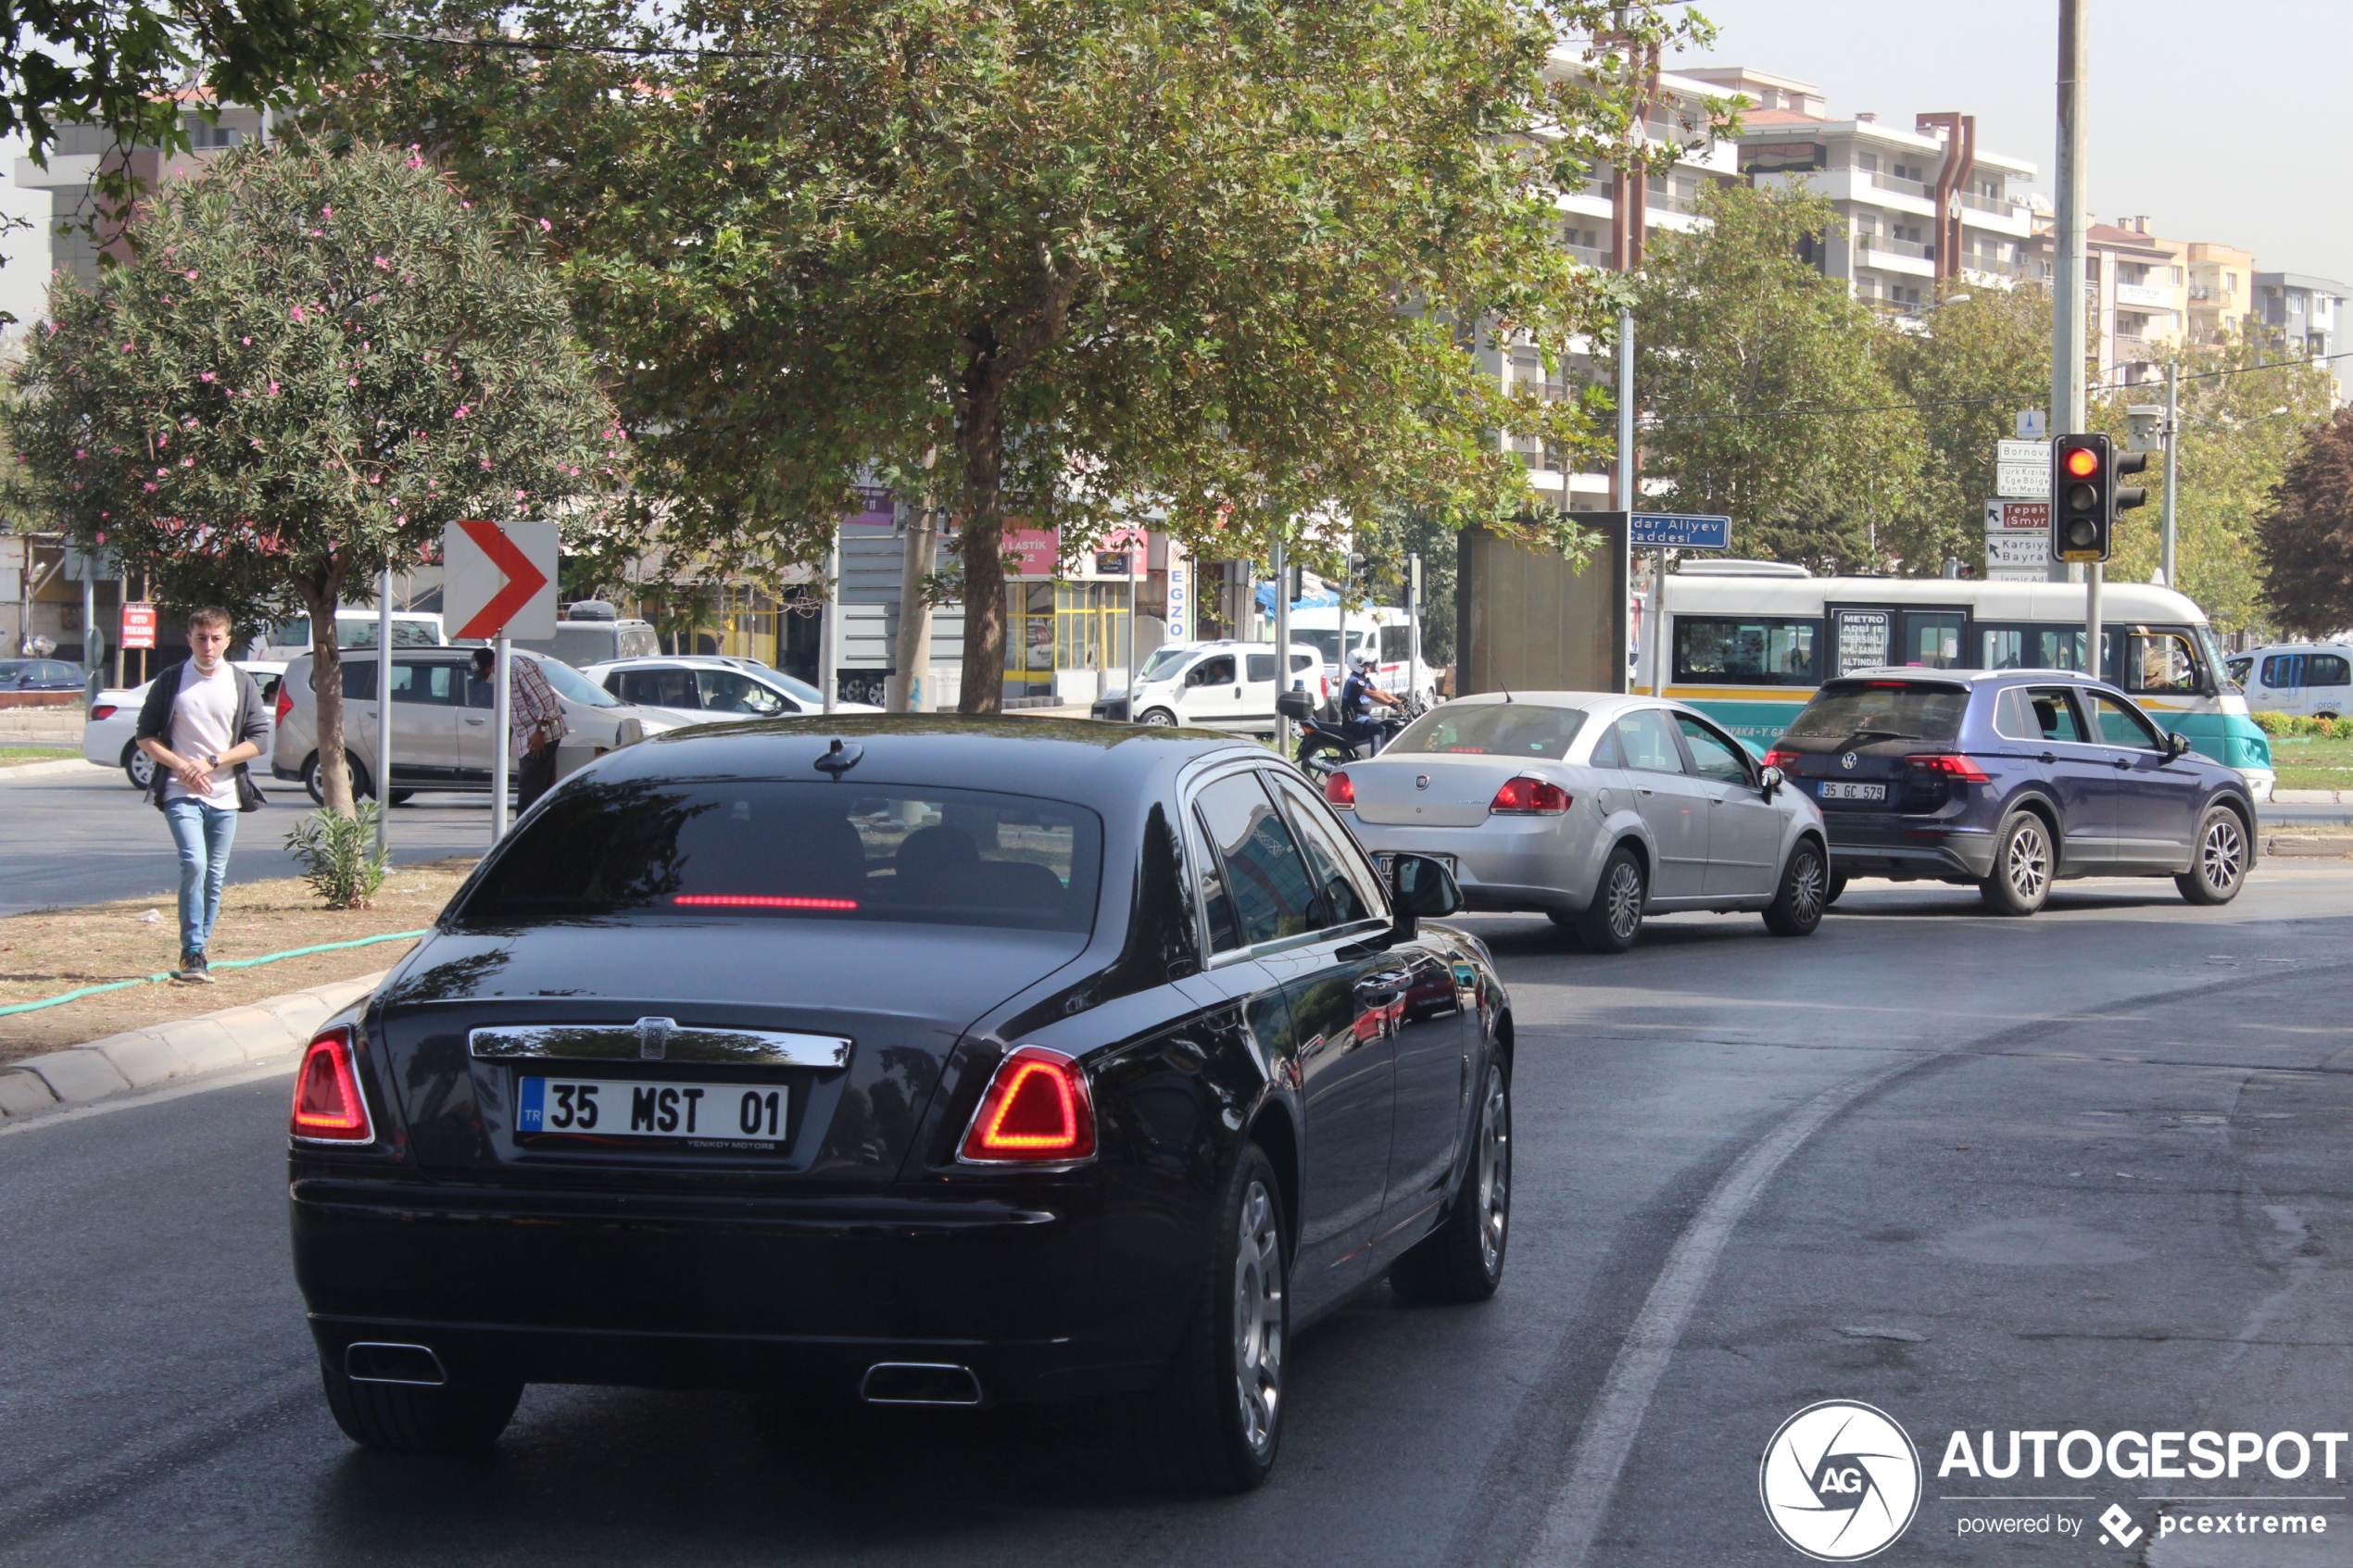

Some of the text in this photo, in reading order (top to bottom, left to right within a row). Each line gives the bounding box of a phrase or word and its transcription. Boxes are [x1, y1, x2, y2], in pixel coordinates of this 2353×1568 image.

[2003, 446, 2050, 457] Bornova
[2001, 467, 2020, 476] Türk
[2005, 476, 2049, 487] Ege Bölge
[2006, 505, 2050, 515] Tepek
[1631, 518, 1718, 533] dar Aliyev
[2006, 516, 2050, 527] (Smyr
[1630, 531, 1691, 543] Caddesi
[1008, 539, 1047, 550] LASTİK
[1170, 571, 1184, 636] EGZO
[131, 615, 148, 624] OTO
[1843, 615, 1884, 623] METRO
[123, 625, 154, 635] YIKAMA
[1843, 633, 1884, 645] MERSİNLİ
[1858, 644, 1885, 656] SANAYİ
[1842, 657, 1883, 667] ALTINDAĞ
[1770, 728, 1788, 737] GA
[1824, 784, 1882, 799] 35 GC 579
[524, 1085, 779, 1135] TR 35 MST 01
[731, 1142, 775, 1150] MOTORS
